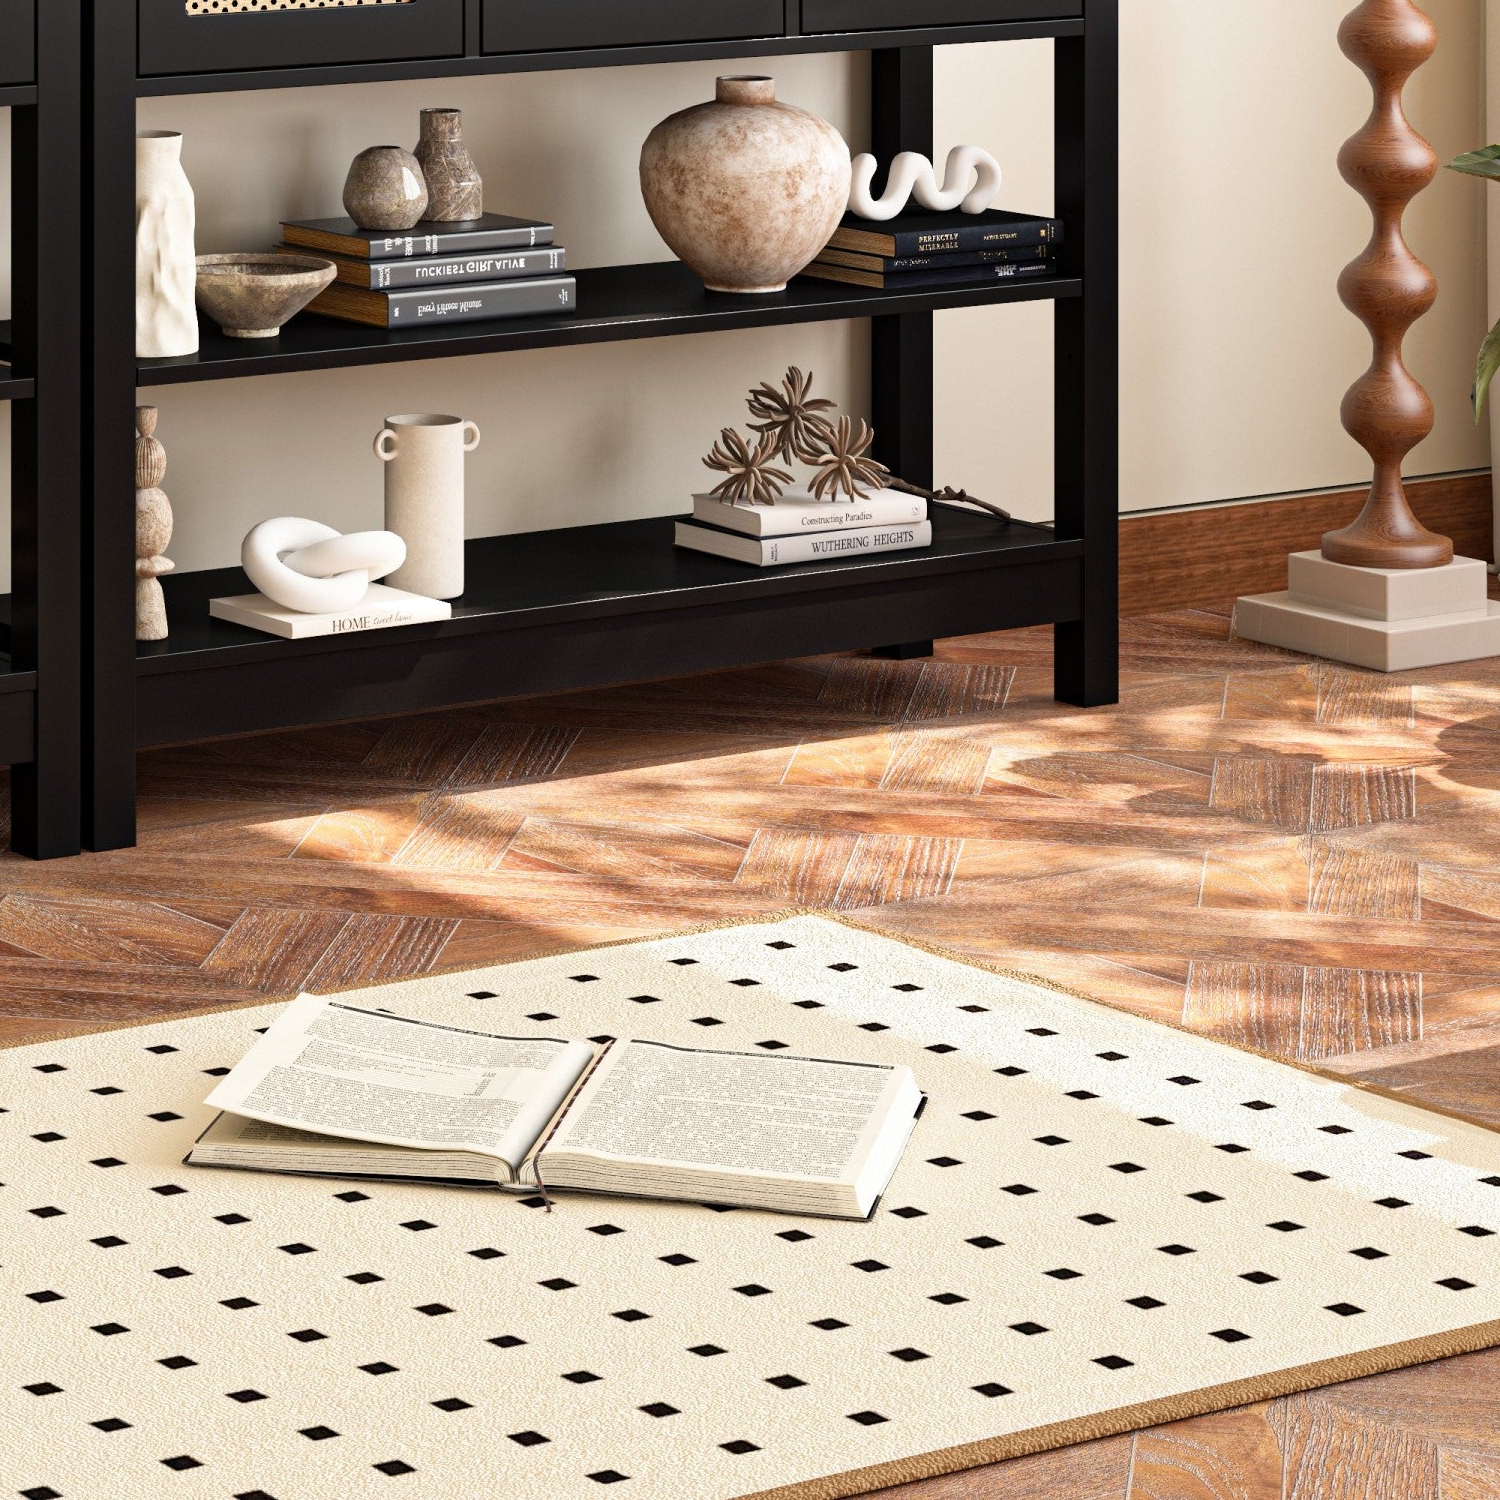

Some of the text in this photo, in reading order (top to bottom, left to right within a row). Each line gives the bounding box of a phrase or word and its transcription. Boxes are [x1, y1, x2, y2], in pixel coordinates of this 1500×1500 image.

[918, 232, 959, 244] PERFECTLY
[801, 513, 844, 526] Constructing
[811, 530, 914, 554] WUTHERING HEIGHTS
[332, 615, 371, 632] HOME
